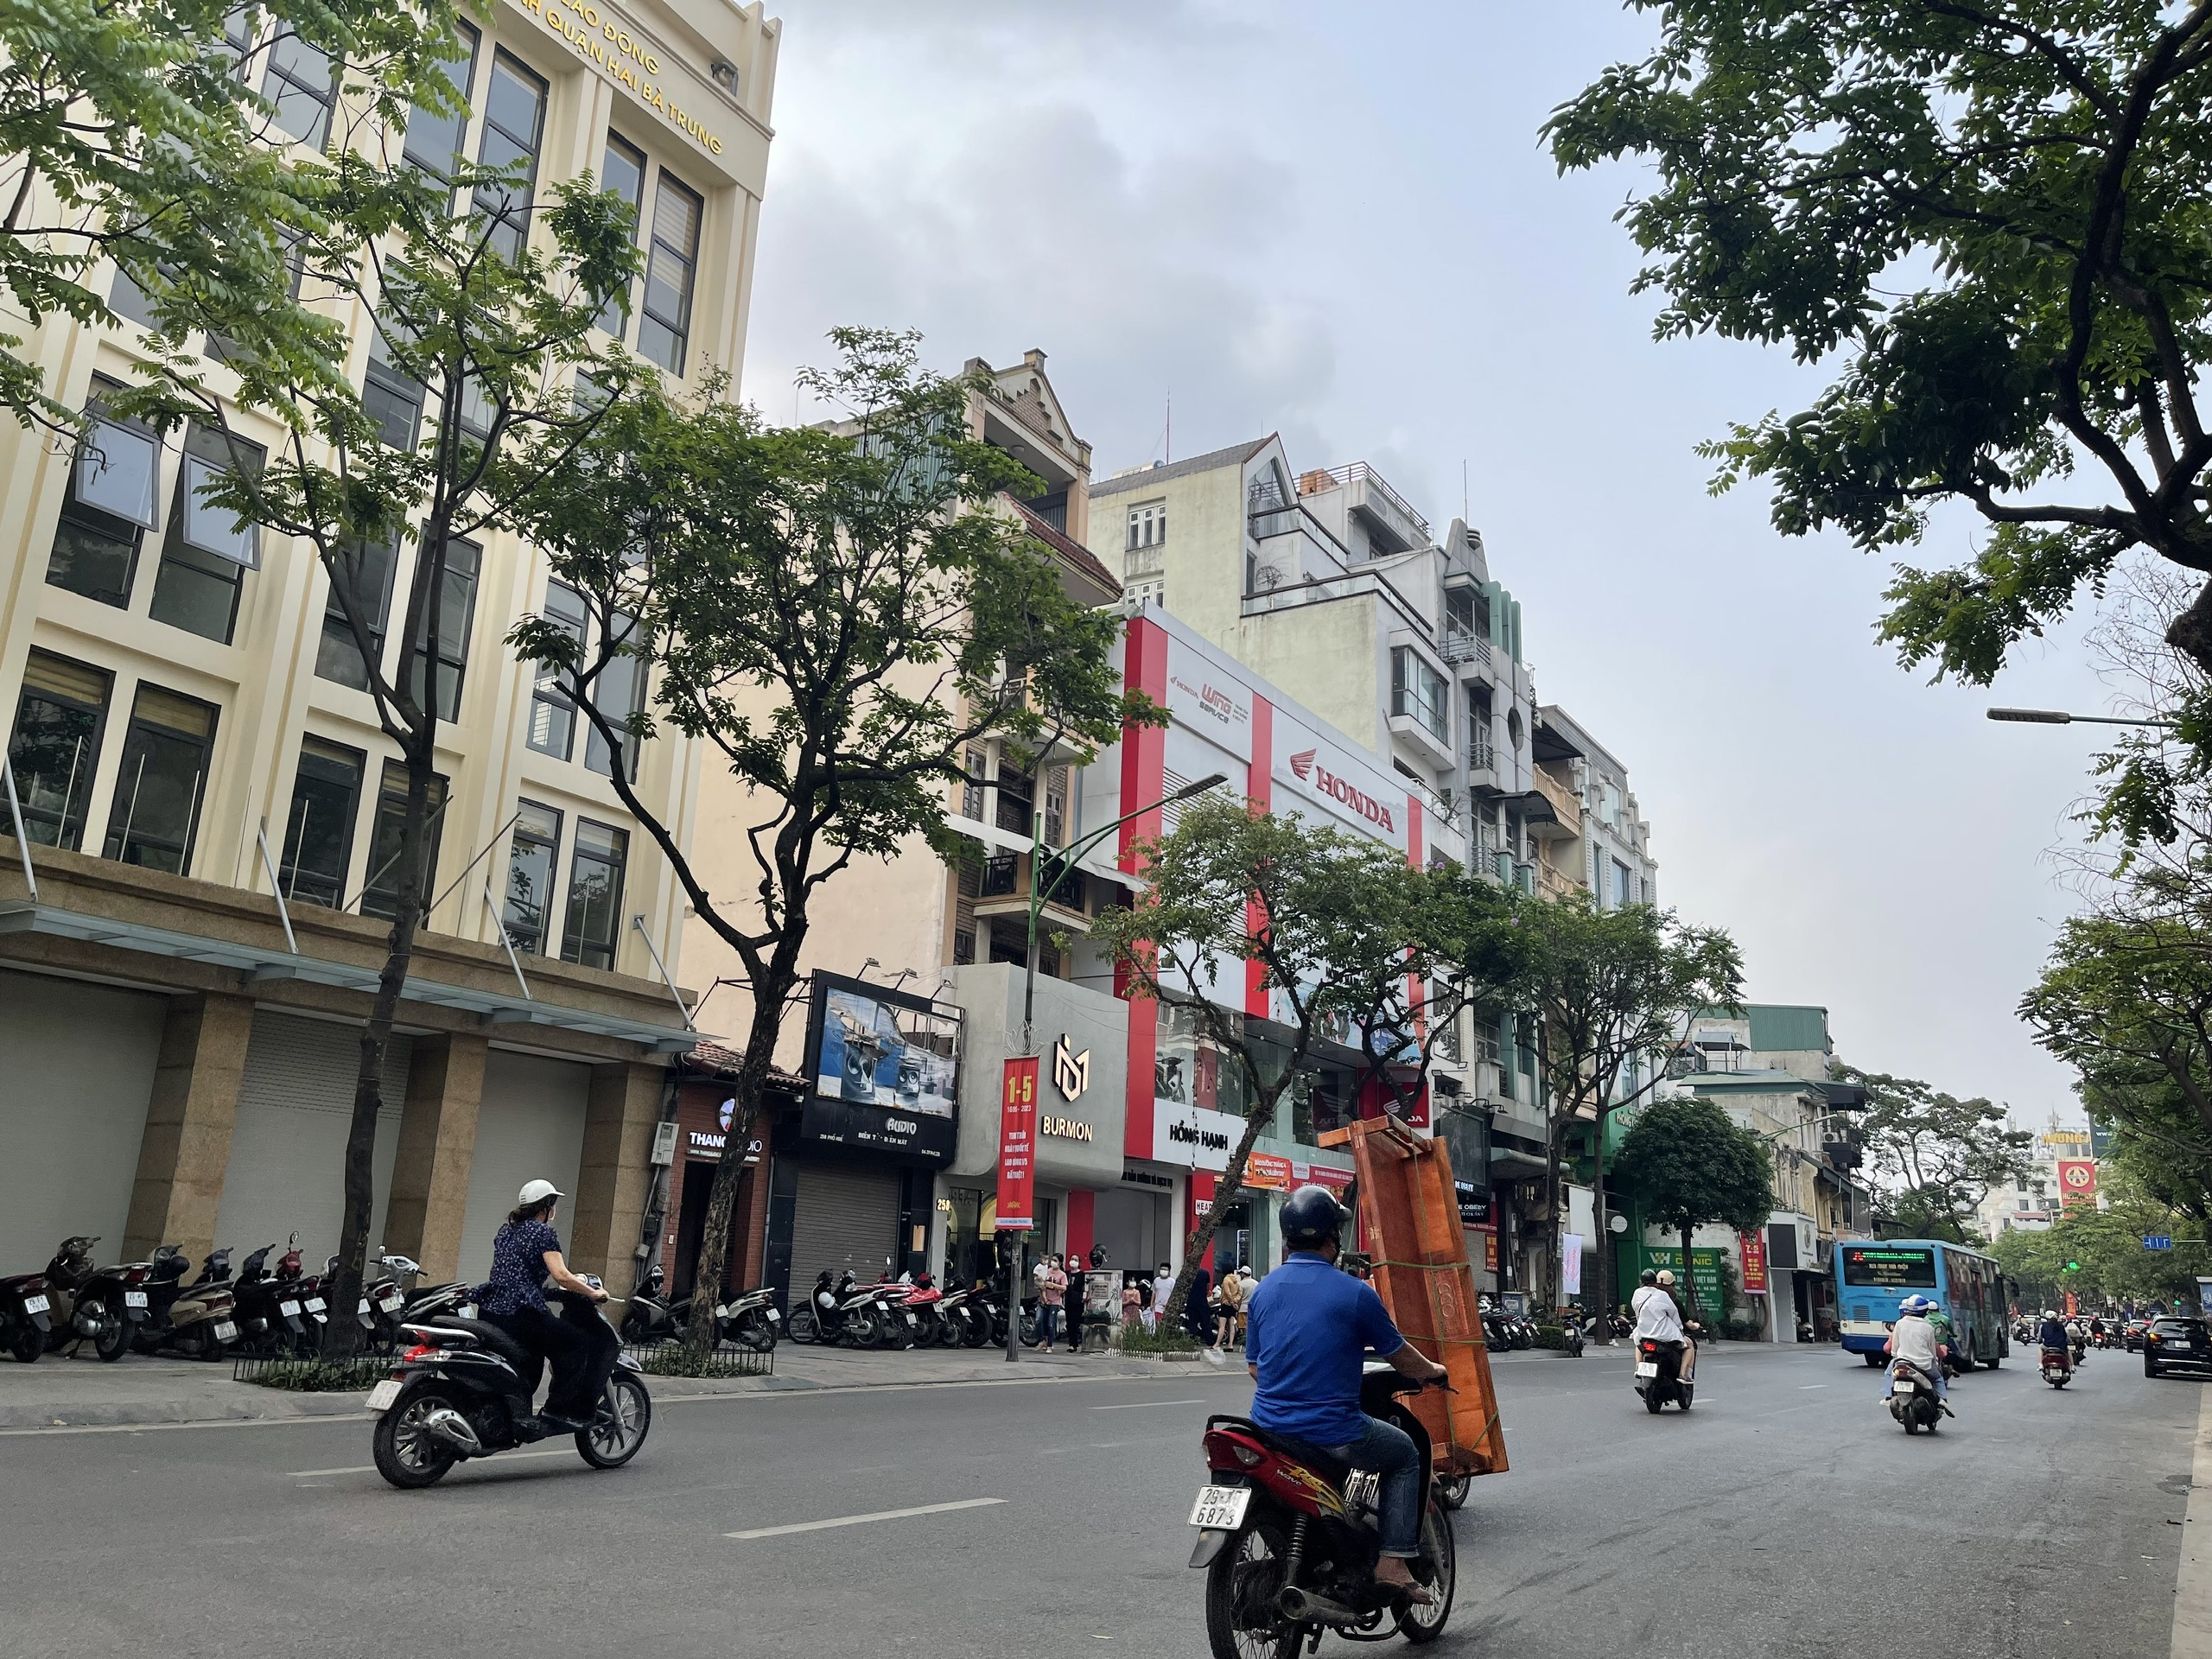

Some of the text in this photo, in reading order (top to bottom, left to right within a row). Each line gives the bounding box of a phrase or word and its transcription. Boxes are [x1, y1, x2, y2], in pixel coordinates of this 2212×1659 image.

[546, 9, 603, 63] QUẬN
[607, 54, 638, 92] HAI
[642, 86, 664, 113] BÀ
[603, 21, 659, 75] ĐỘNG
[1176, 680, 1199, 701] HONDA
[1316, 766, 1395, 834] HONDA
[1008, 1075, 1033, 1103] 1-5
[886, 1116, 918, 1135] AUDIO
[1043, 1116, 1093, 1141] BURMON
[1170, 1119, 1229, 1151] HỒNG HẠNH
[937, 1198, 950, 1211] 258
